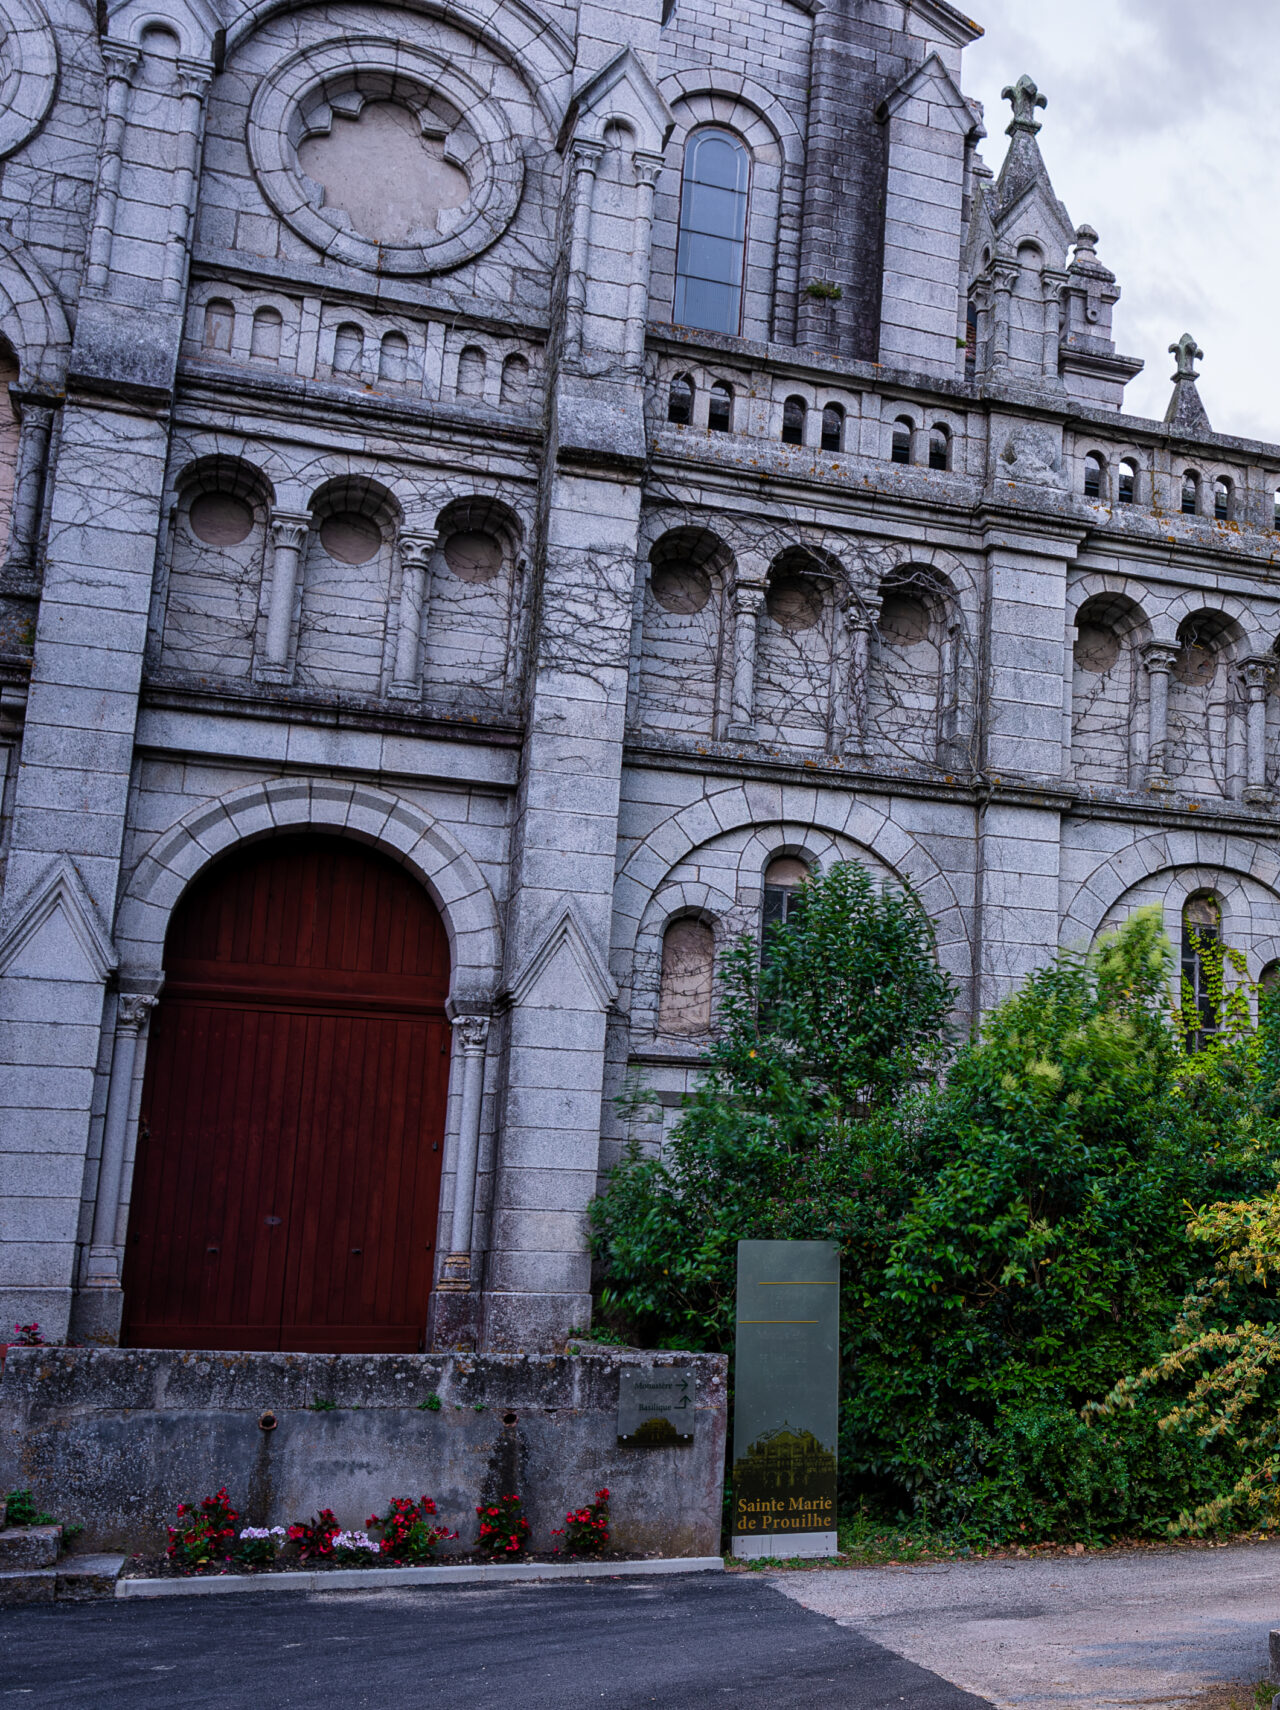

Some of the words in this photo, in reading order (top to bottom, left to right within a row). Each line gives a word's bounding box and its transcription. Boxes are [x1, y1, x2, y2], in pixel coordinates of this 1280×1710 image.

[638, 1402, 672, 1413] Basilique
[738, 1498, 785, 1513] Sainte
[788, 1496, 833, 1511] Marie
[737, 1515, 757, 1530] de
[761, 1513, 832, 1529] Prouilhe
